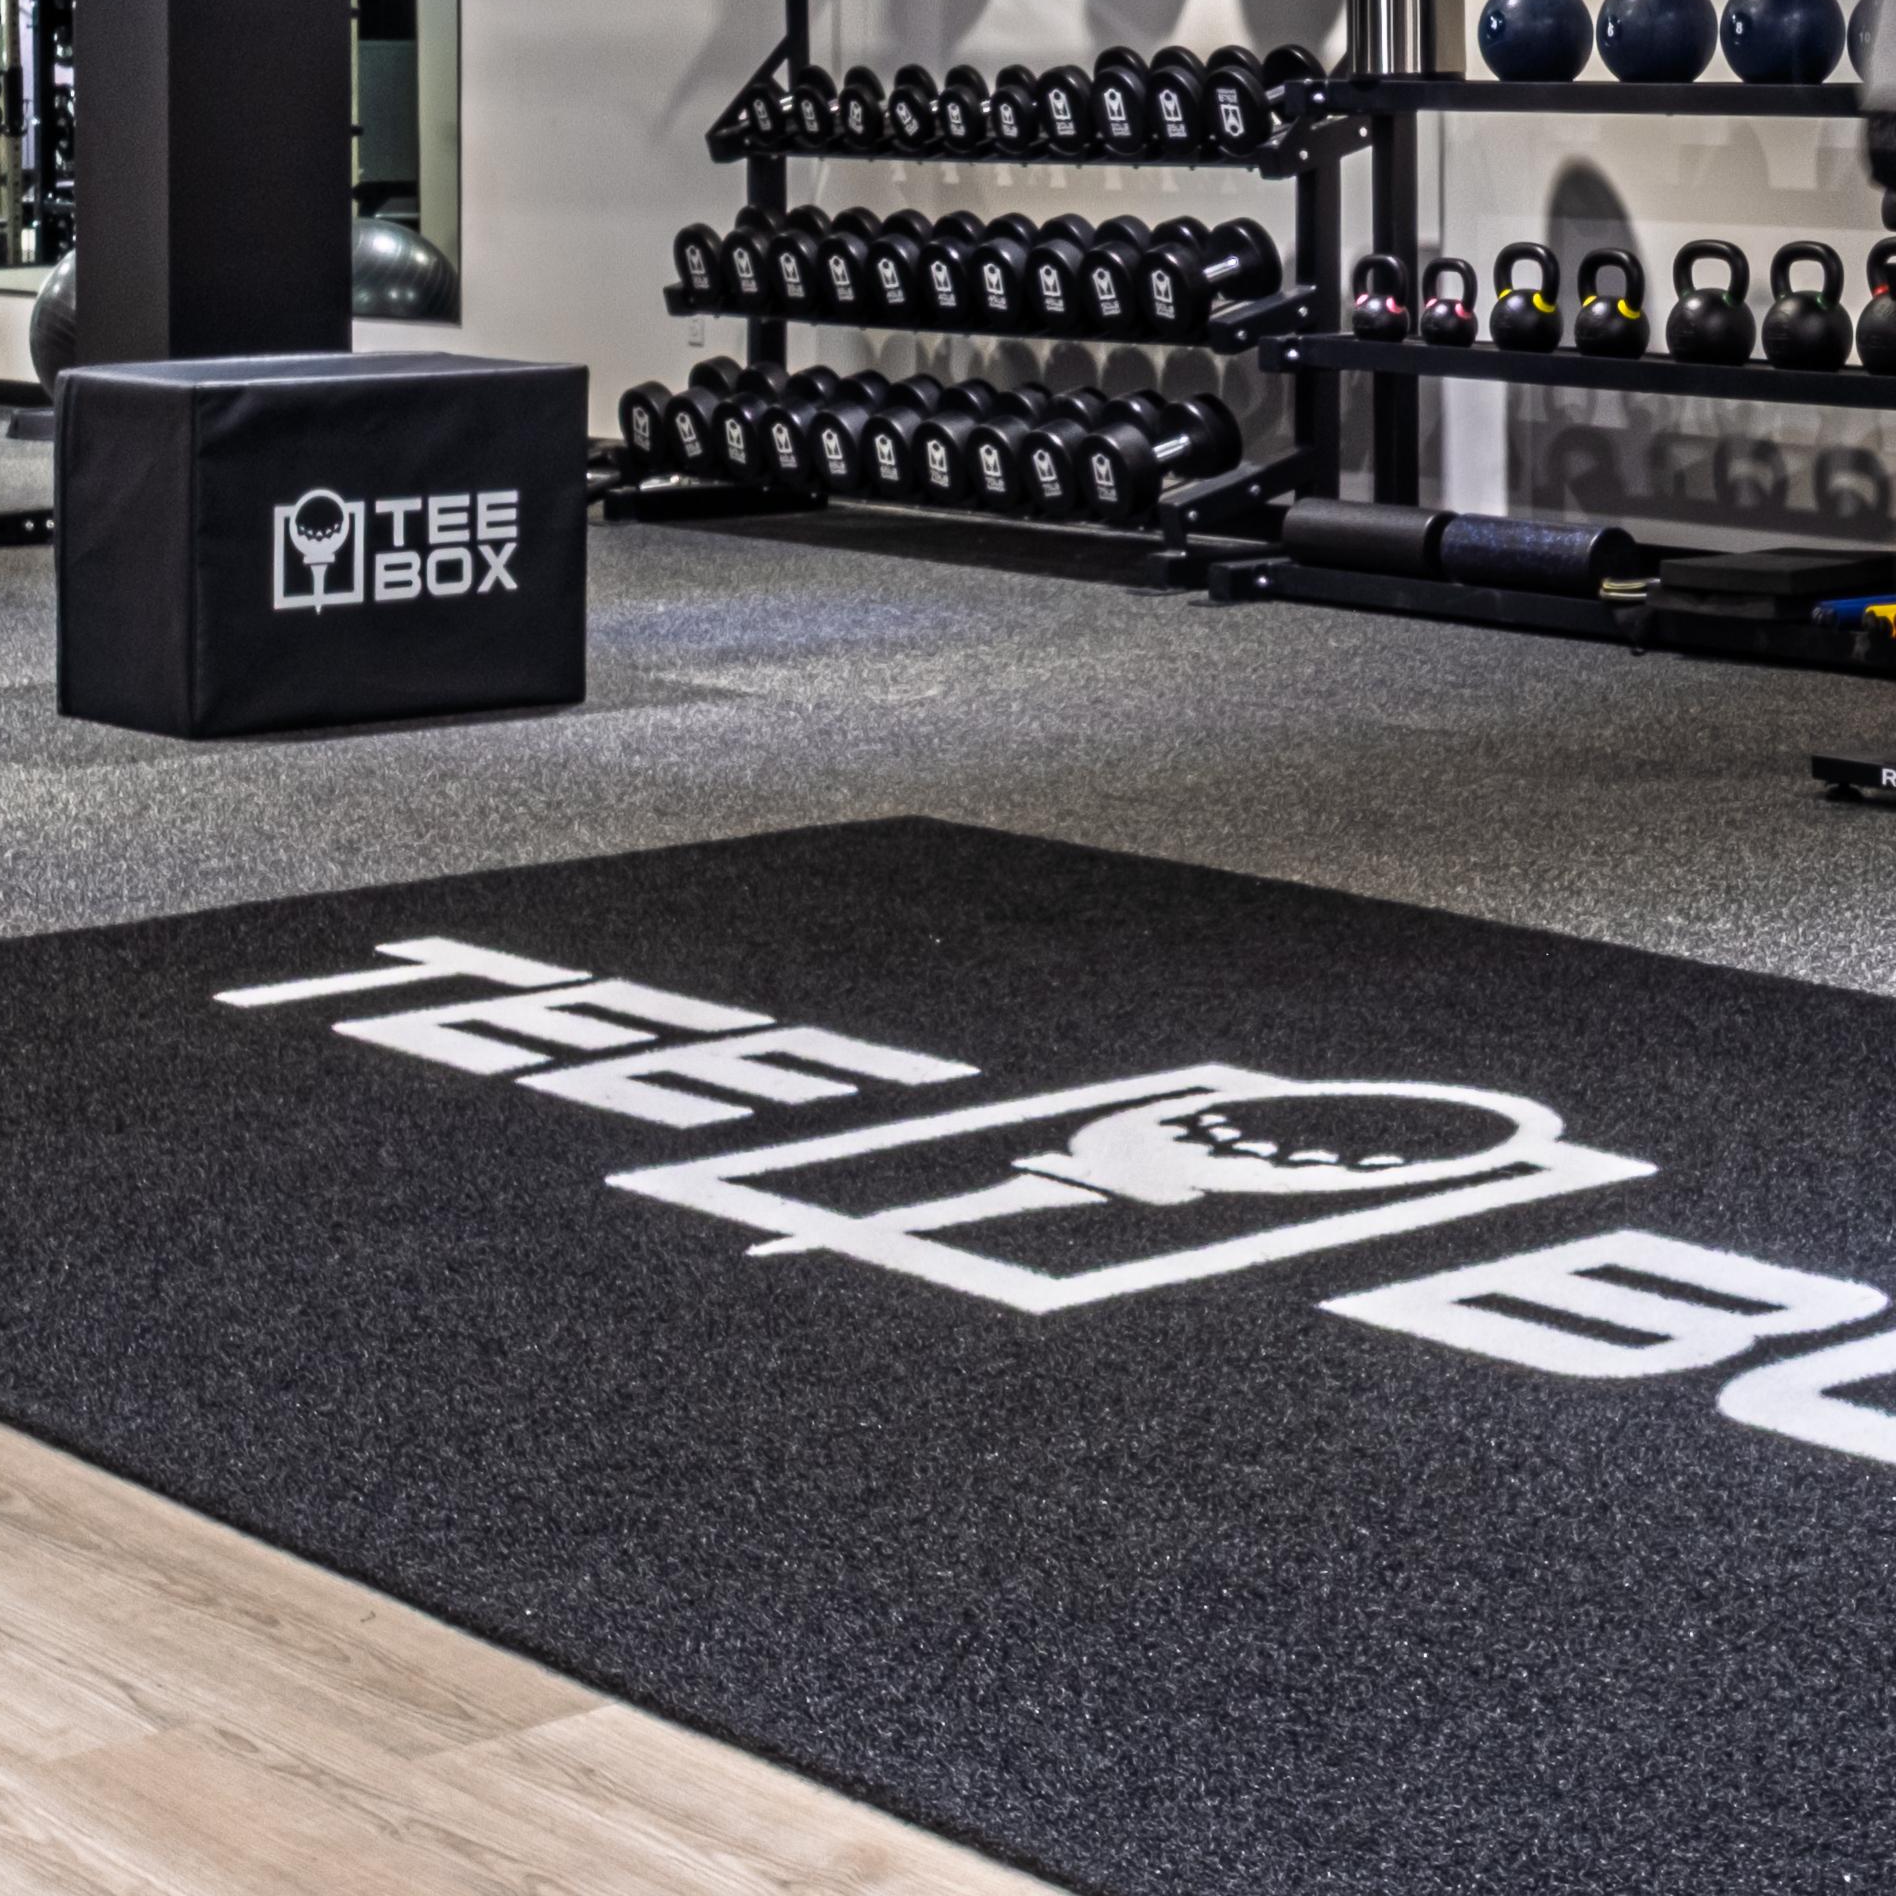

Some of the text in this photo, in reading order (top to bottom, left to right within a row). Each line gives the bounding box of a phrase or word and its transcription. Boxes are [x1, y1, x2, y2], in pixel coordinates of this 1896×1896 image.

[1735, 21, 1744, 36] 8
[1858, 31, 1872, 44] 10
[375, 488, 519, 547] TEE
[374, 542, 518, 601] BOX
[214, 934, 982, 1129] TEE
